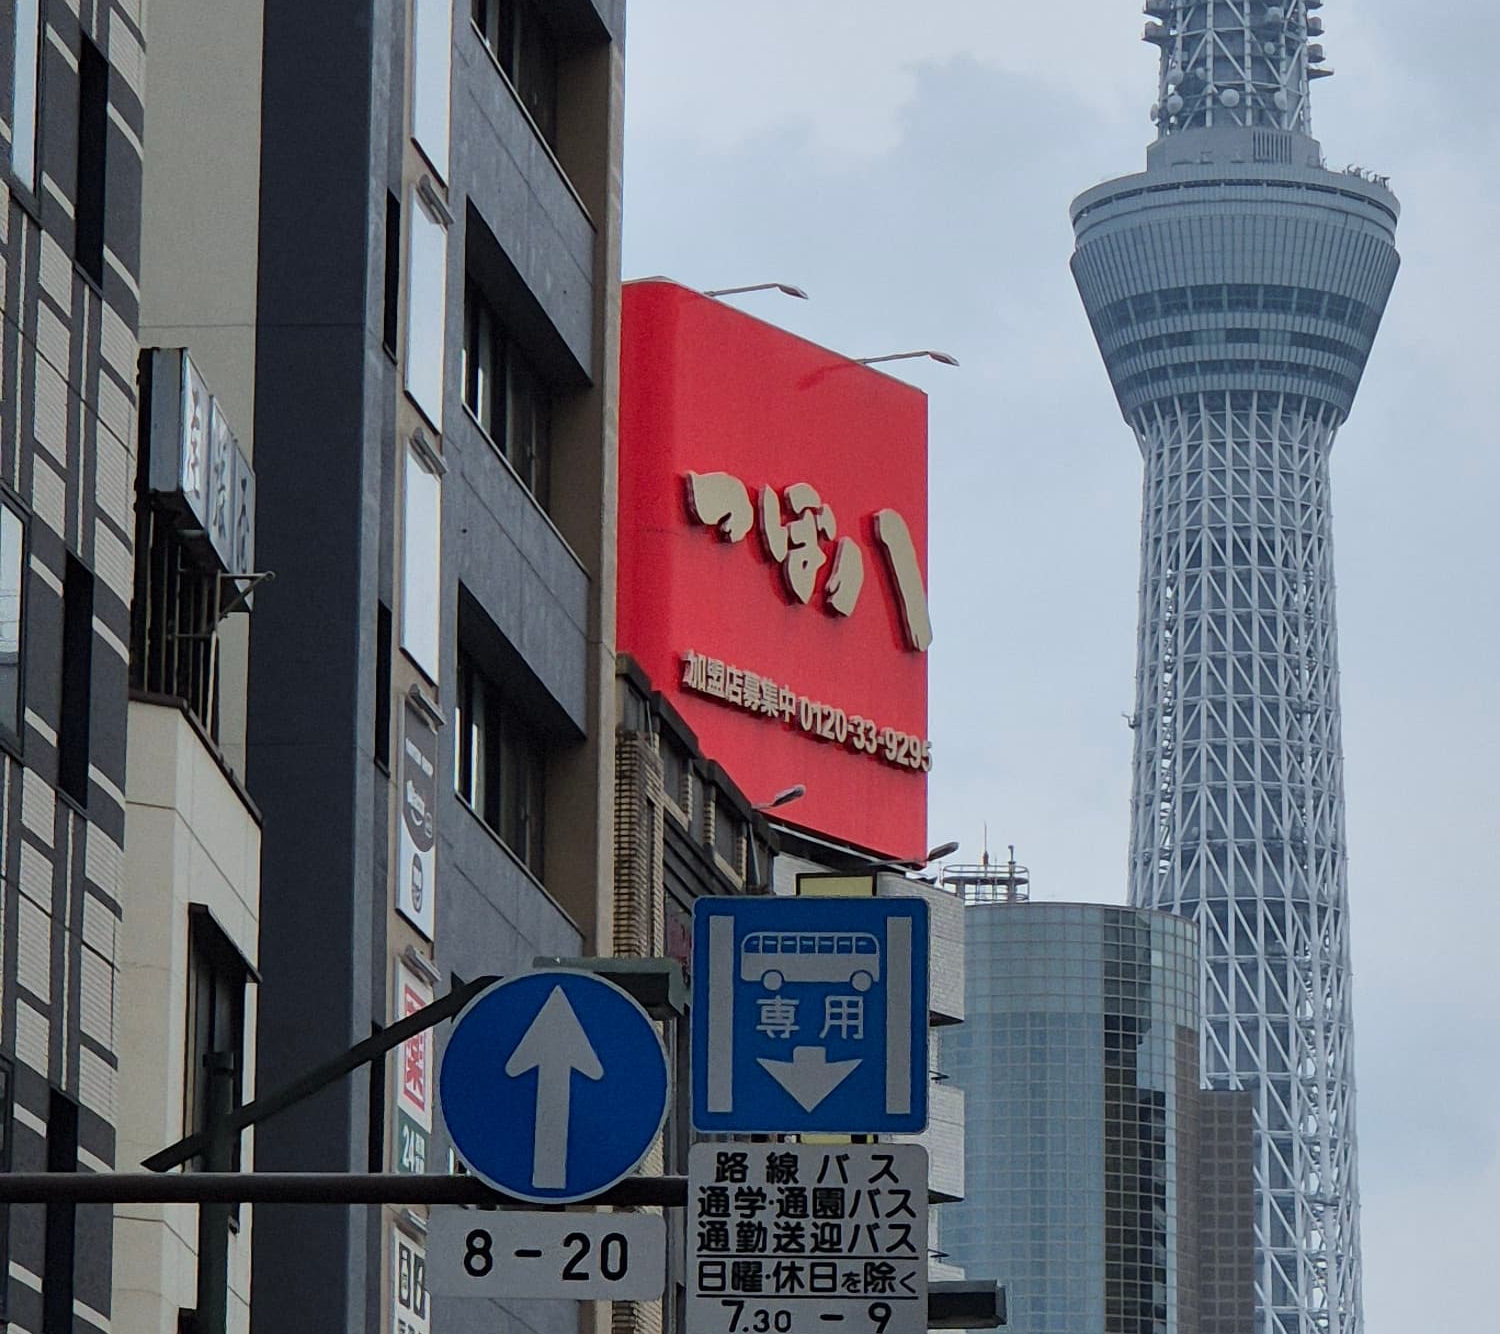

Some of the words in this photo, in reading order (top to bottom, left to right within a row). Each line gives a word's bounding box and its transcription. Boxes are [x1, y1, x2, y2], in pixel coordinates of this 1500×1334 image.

[686, 470, 933, 652] つぼ八
[681, 648, 796, 724] 加盟店募集中
[798, 695, 933, 772] 0120-33-9295
[755, 995, 865, 1041] 専用
[714, 1150, 900, 1185] 路線バス
[463, 1227, 629, 1281] 8-20
[697, 1220, 917, 1253] 通勤送迎バス
